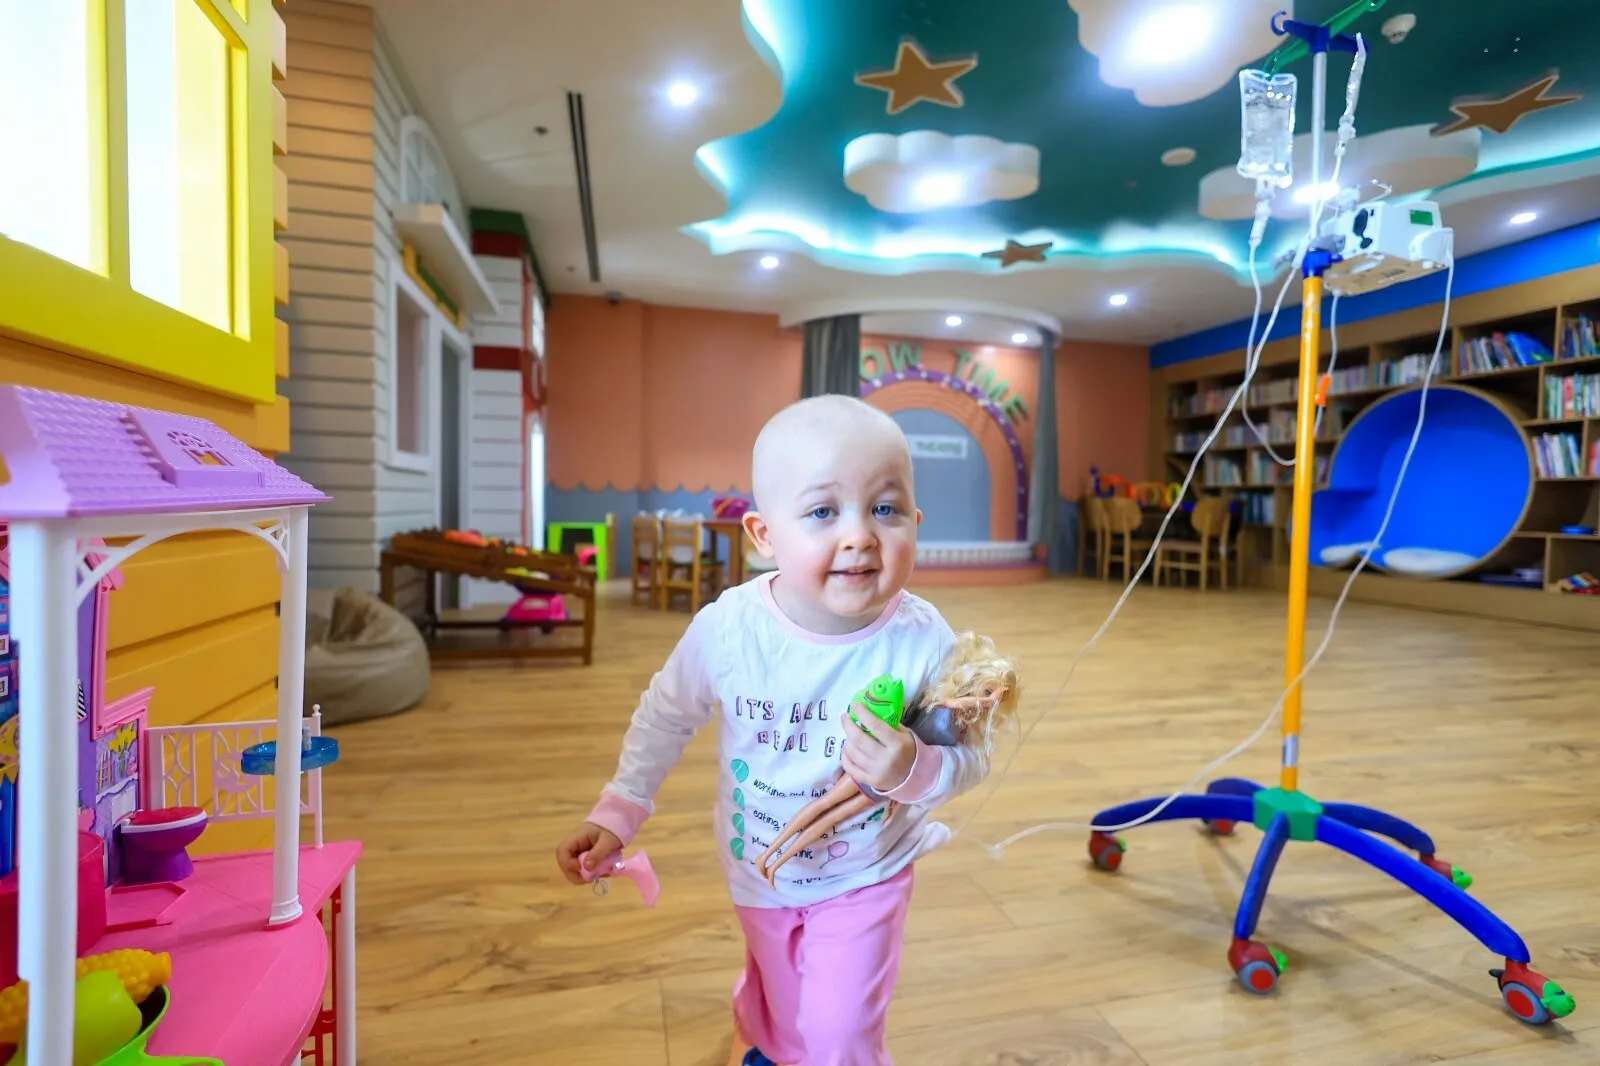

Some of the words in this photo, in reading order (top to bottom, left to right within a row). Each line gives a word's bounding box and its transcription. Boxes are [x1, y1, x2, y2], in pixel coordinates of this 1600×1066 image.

[954, 348, 1029, 424] TIME
[736, 695, 775, 720] IT'S
[790, 700, 828, 723] ALL
[824, 736, 846, 760] G
